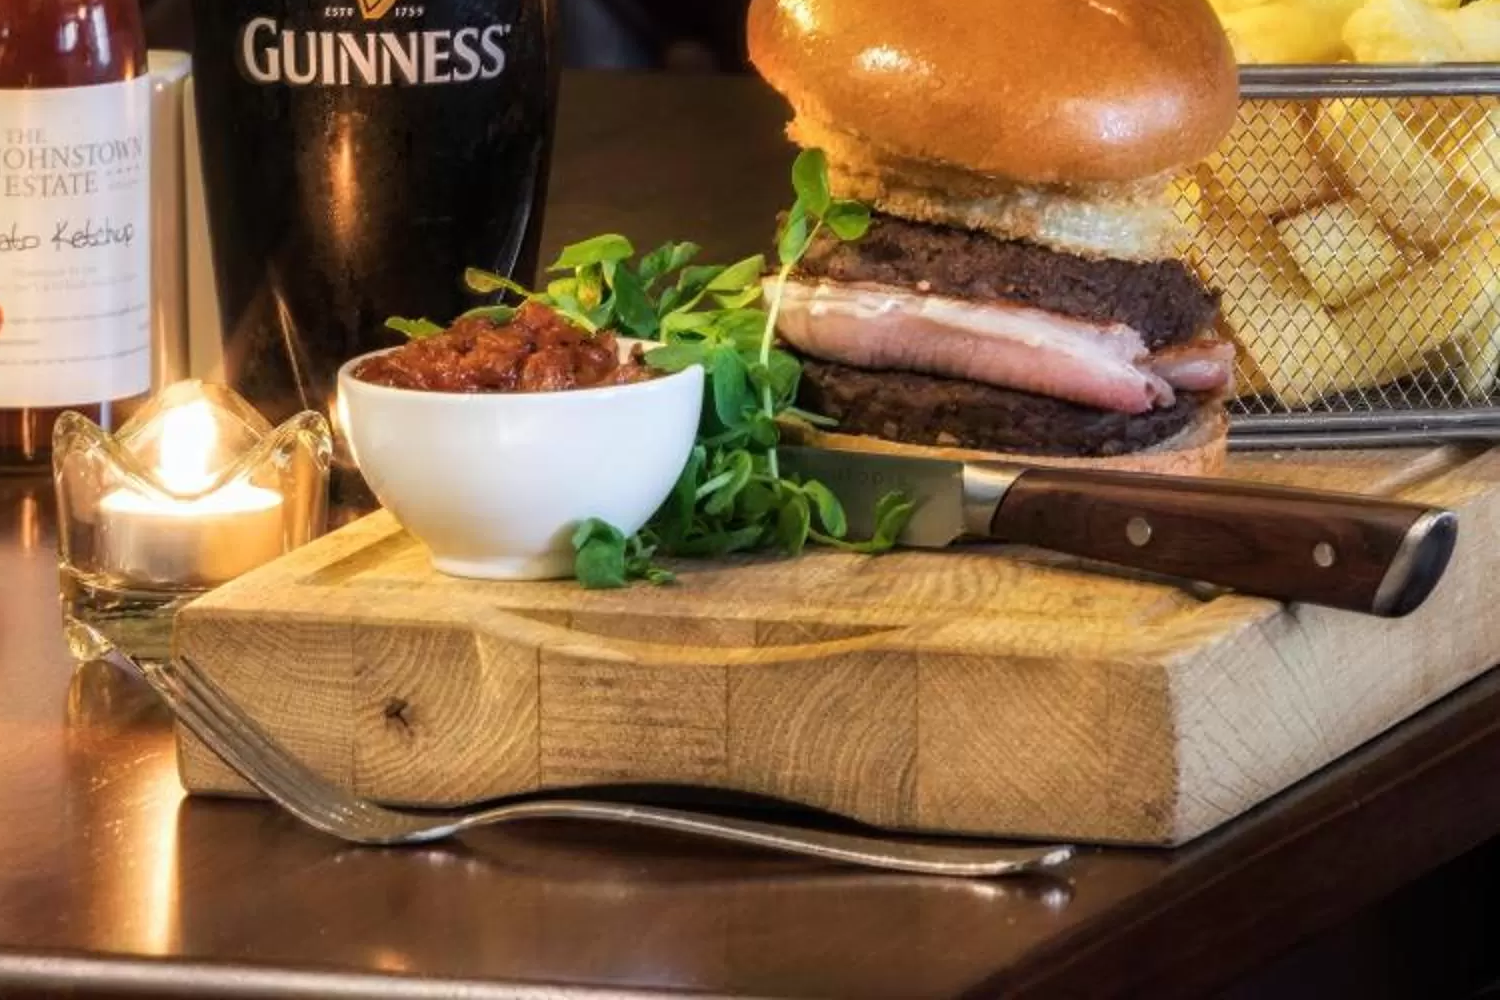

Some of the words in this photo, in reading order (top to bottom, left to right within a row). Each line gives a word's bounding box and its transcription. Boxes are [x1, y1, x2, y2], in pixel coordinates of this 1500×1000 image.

[394, 5, 425, 18] 1759
[243, 17, 506, 86] GUINNESS
[4, 127, 48, 145] THE
[3, 169, 99, 199] ESTATE
[51, 215, 134, 252] Ketchup
